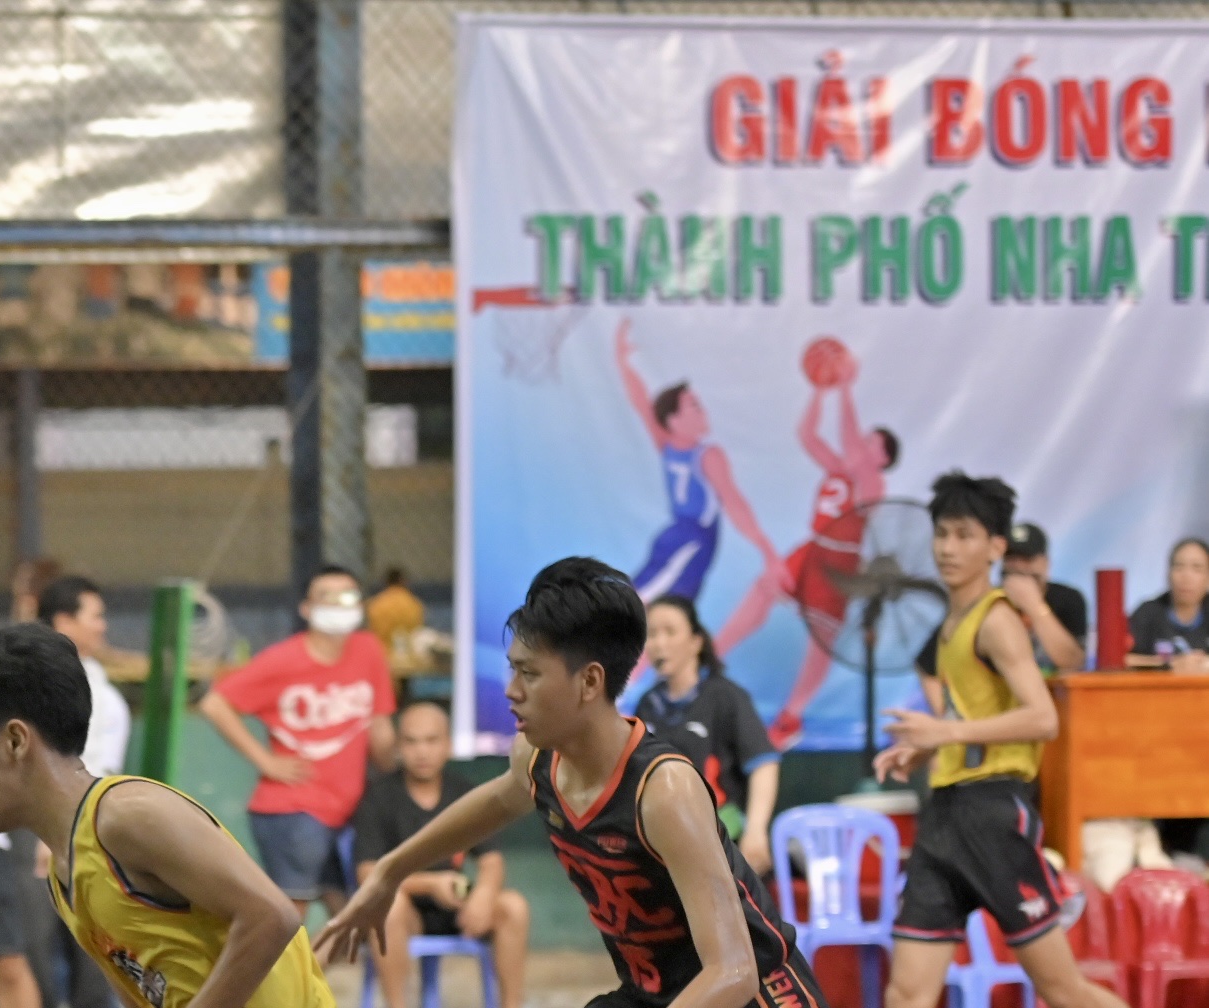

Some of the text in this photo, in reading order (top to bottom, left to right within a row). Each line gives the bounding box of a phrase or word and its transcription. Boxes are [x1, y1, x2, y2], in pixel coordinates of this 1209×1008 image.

[709, 48, 893, 167] GIẢI
[927, 54, 1174, 169] BÓNG
[527, 181, 1209, 306] THÀNH PHỐ NHA T
